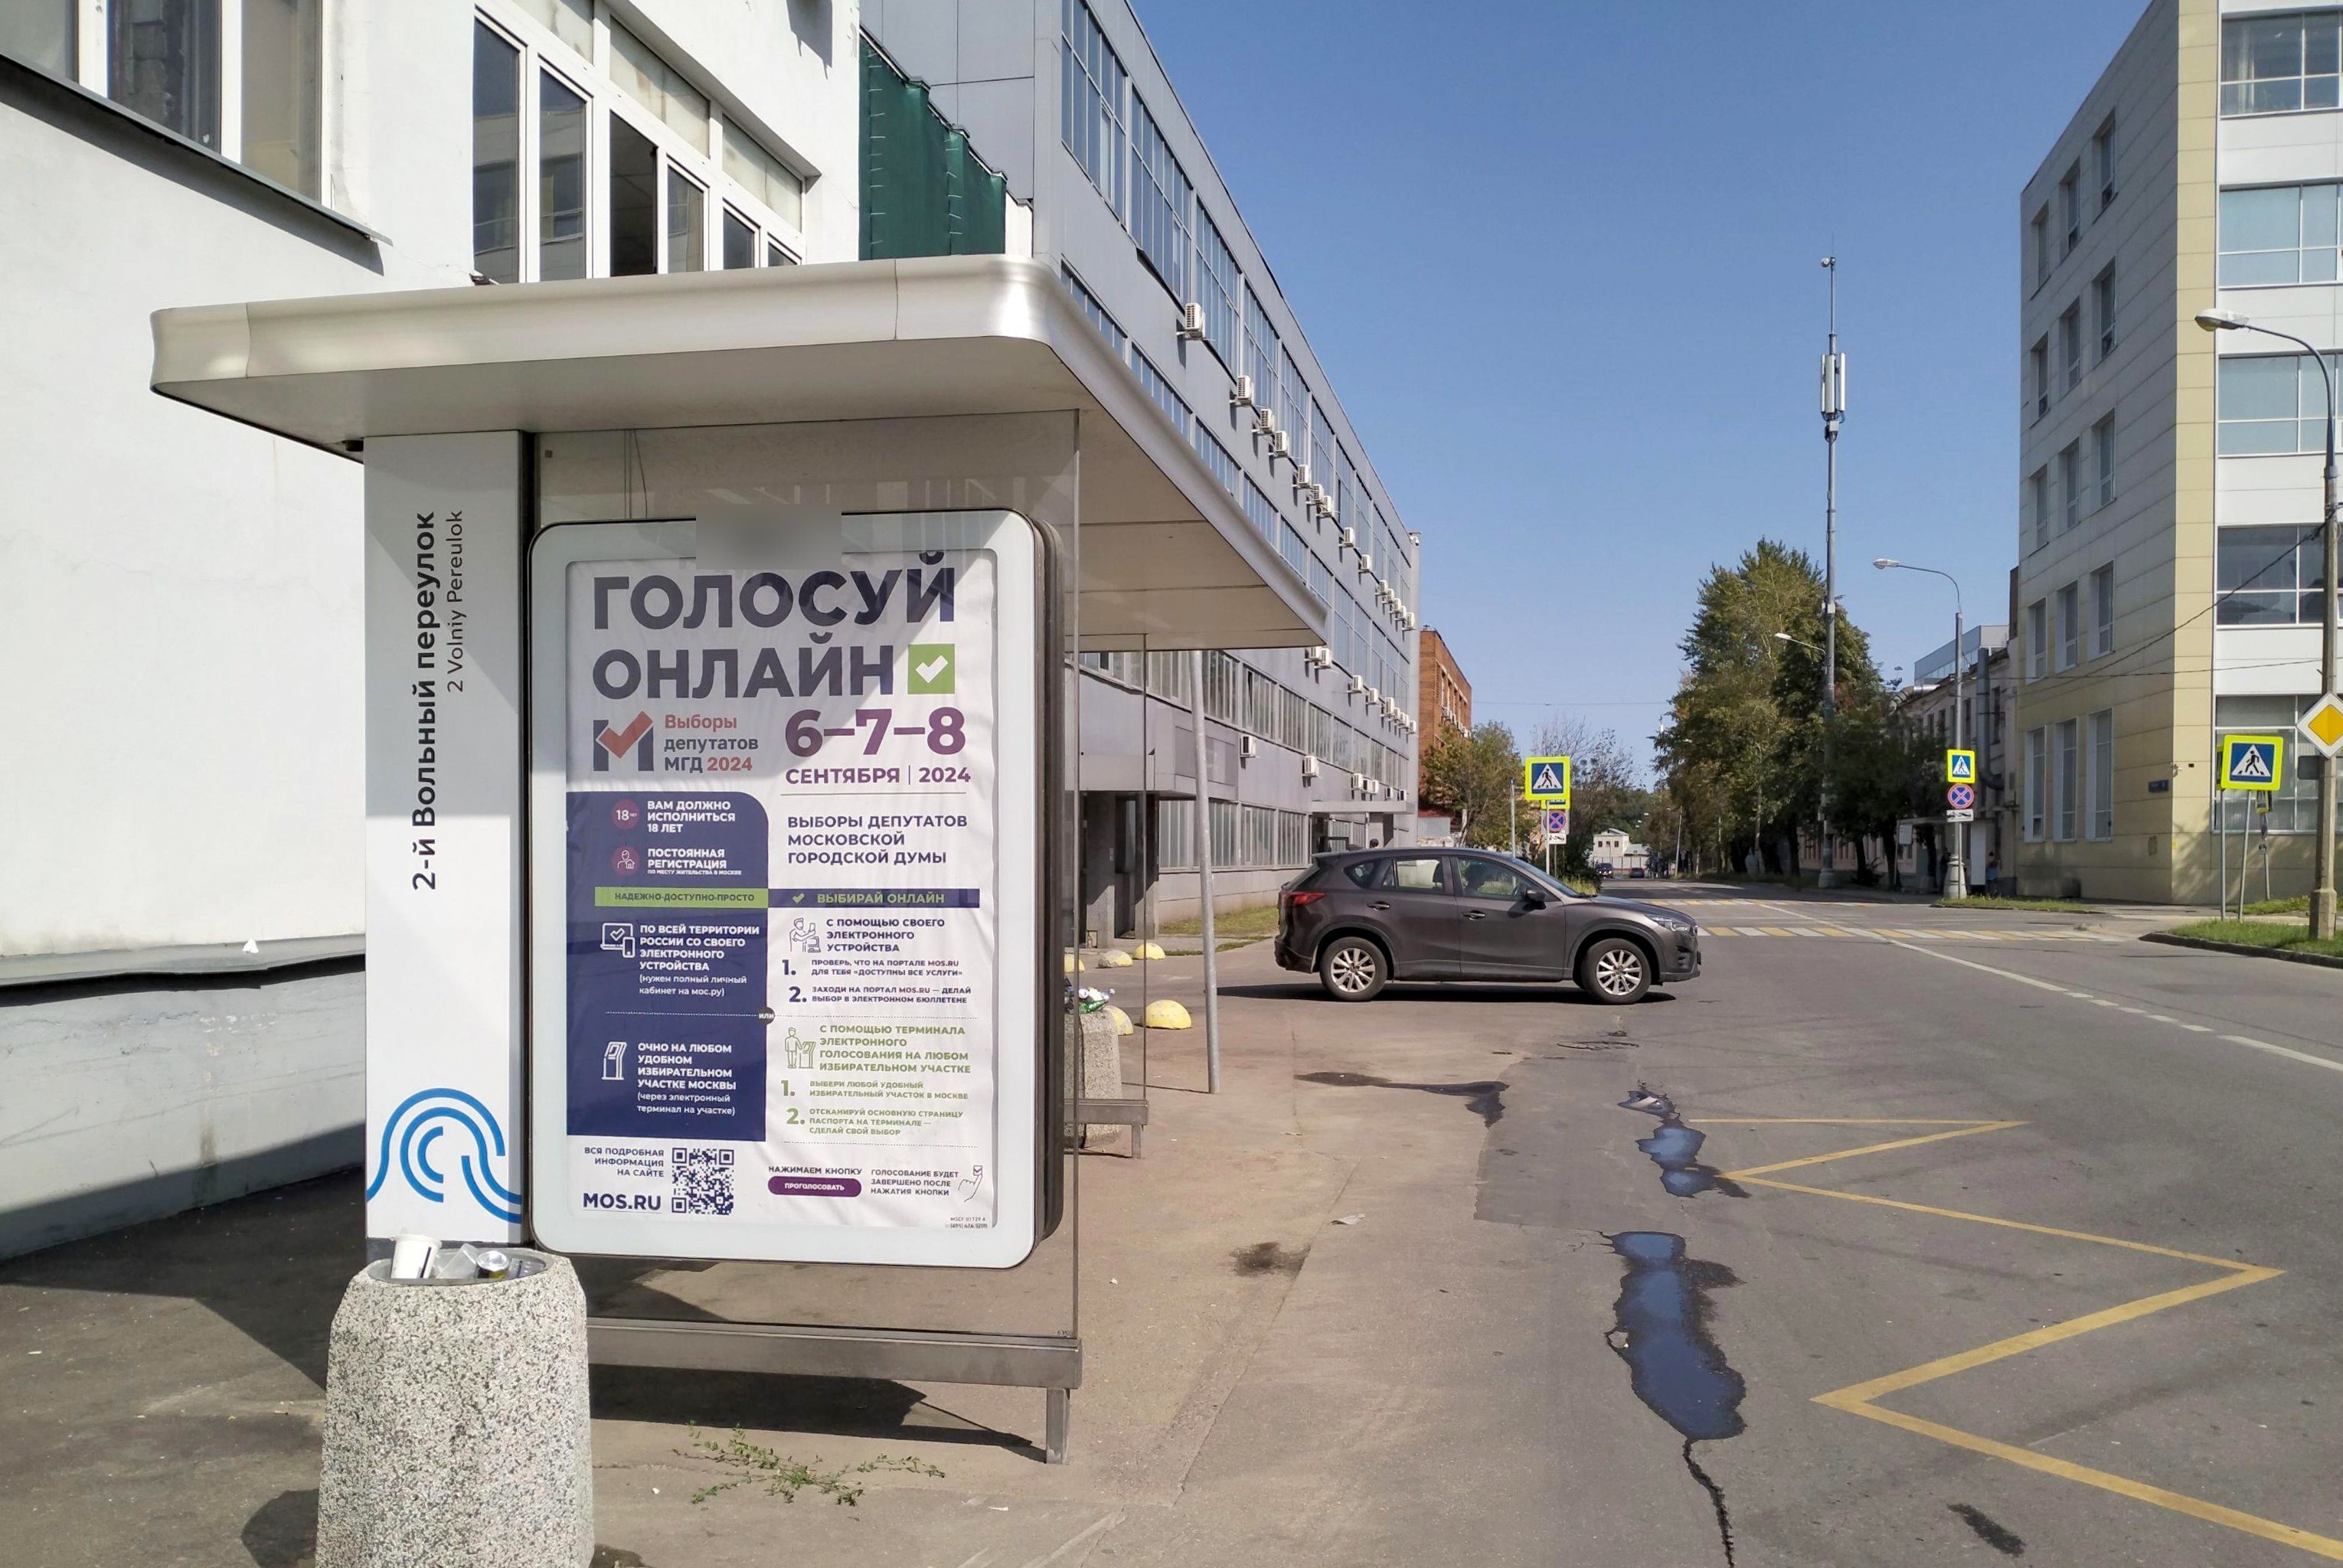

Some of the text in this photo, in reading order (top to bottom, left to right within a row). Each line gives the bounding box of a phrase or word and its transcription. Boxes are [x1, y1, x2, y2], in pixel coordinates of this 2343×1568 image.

[593, 550, 955, 630] ГОЛОСУЙ
[446, 510, 466, 692] 2 Volniy Pereulok
[592, 632, 894, 700] ОНЛАЙН
[411, 511, 440, 890] 2-й Вольный переулок
[665, 714, 737, 732] Выборы
[664, 738, 759, 753] депутатов
[665, 756, 753, 773] МГД 2024
[786, 766, 971, 785] СЕНТЯБРЯ 2024
[647, 801, 731, 812] ВАМ ДОЛЖНО
[616, 809, 629, 821] 18
[647, 812, 736, 822] ИСПОЛНИТЬСЯ
[787, 815, 968, 829] ВЫБОРЫ ДЕПУТАТОВ
[647, 824, 684, 833] 18 ЛЕТ
[787, 831, 905, 846] МОСКОВСКОЙ
[647, 848, 725, 858] ПОСТОЯННАЯ
[788, 849, 946, 865] ГОРОДСКОЙ ДУМЫ
[647, 859, 727, 870] РЕГИСТРАЦИЯ
[817, 890, 945, 903] ВЫБИРАЙ ОНЛАЙН
[640, 923, 760, 935] ПО ВСЕЙ ТЕРРИТОРИИ
[826, 918, 945, 929] С ПОМОЩЬЮ СВОЕГО
[826, 931, 915, 940] ЭЛЕКТРОННОГО
[640, 937, 746, 947] РОССИИ СО СВОЕГО
[827, 942, 900, 952] УСТРОЙСТВА
[639, 949, 725, 959] ЭЛЕКТРОННОГО
[639, 960, 710, 971] УСТРОЙСТВА
[782, 959, 796, 975] 1.
[639, 974, 747, 984] (нужен полный личный
[639, 986, 676, 995] кабинет
[691, 988, 725, 997] мос.ру)
[789, 986, 808, 1003] 2.
[942, 986, 971, 995] ДЕЛАЙ
[819, 1025, 965, 1035] С ПОМОЩЬЮ ТЕРМИНАЛА
[819, 1037, 907, 1047] ЭЛЕКТРОННОГО
[638, 1043, 732, 1053] ОЧНО НА ЛЮБОМ
[638, 1055, 692, 1065] УДОБНОМ
[819, 1050, 969, 1060] ГОЛОСОВАНИЯ НА ЛЮБОМ
[638, 1067, 733, 1077] ИЗБИРАТЕЛЬНОМ
[819, 1063, 971, 1073] ИЗБИРАТЕЛЬНОМ УЧАСТКЕ
[638, 1080, 737, 1089] УЧАСТКЕ МОСКВЫ
[781, 1080, 796, 1096] 1.
[637, 1092, 730, 1102] (через электронный
[637, 1105, 681, 1113] терминал
[697, 1106, 735, 1116] участке)
[786, 1108, 806, 1125] 2.
[809, 1126, 843, 1135] СДЕЛАЙ
[605, 1148, 664, 1157] ПОДРОБНАЯ
[594, 1158, 664, 1168] ИНФОРМАЦИЯ
[633, 1168, 664, 1178] САЙТЕ
[871, 1169, 959, 1179] ГОЛОСОВАНИЕ БУДЕТ
[871, 1178, 921, 1187] ЗАВЕРШЕНО
[583, 1192, 662, 1210] MOS.RU
